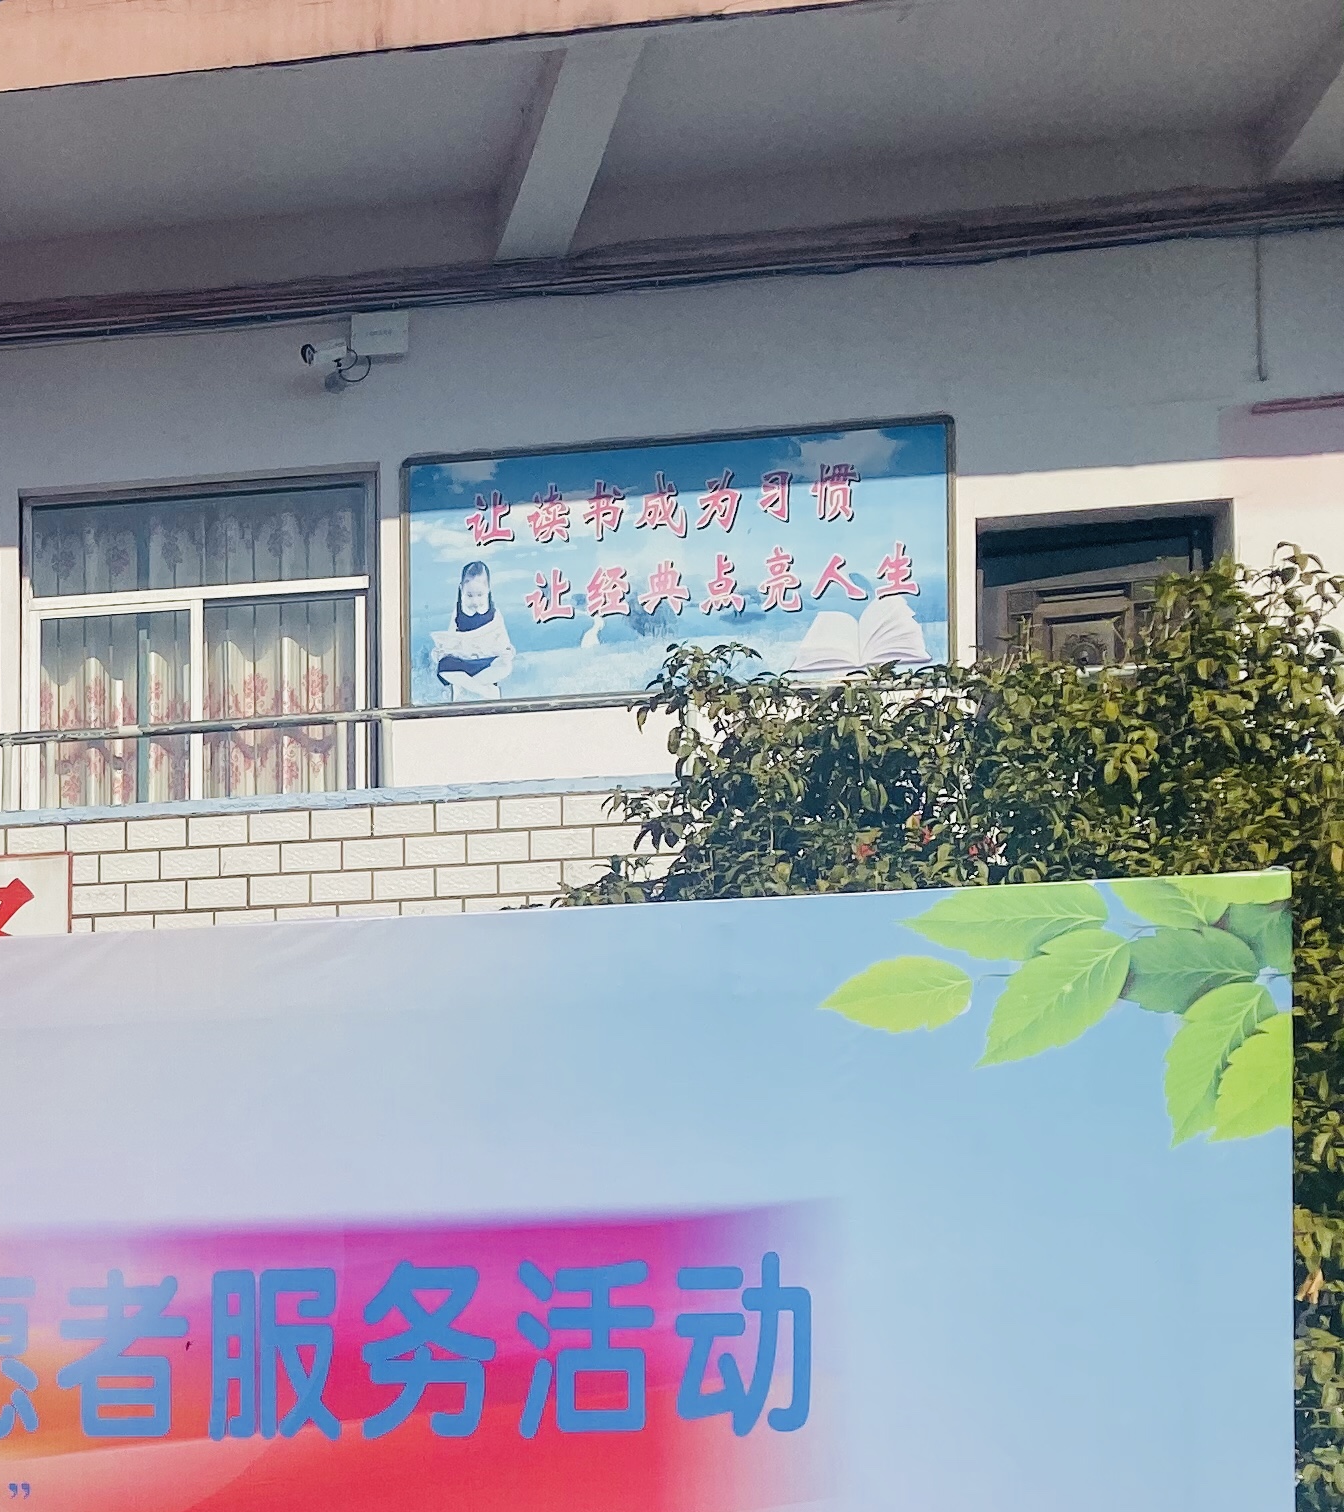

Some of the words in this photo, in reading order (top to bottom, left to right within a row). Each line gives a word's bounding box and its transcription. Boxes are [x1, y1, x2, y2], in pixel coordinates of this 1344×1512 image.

[466, 463, 861, 547] 让读书成为习惯
[525, 541, 921, 623] 让经典点亮人生
